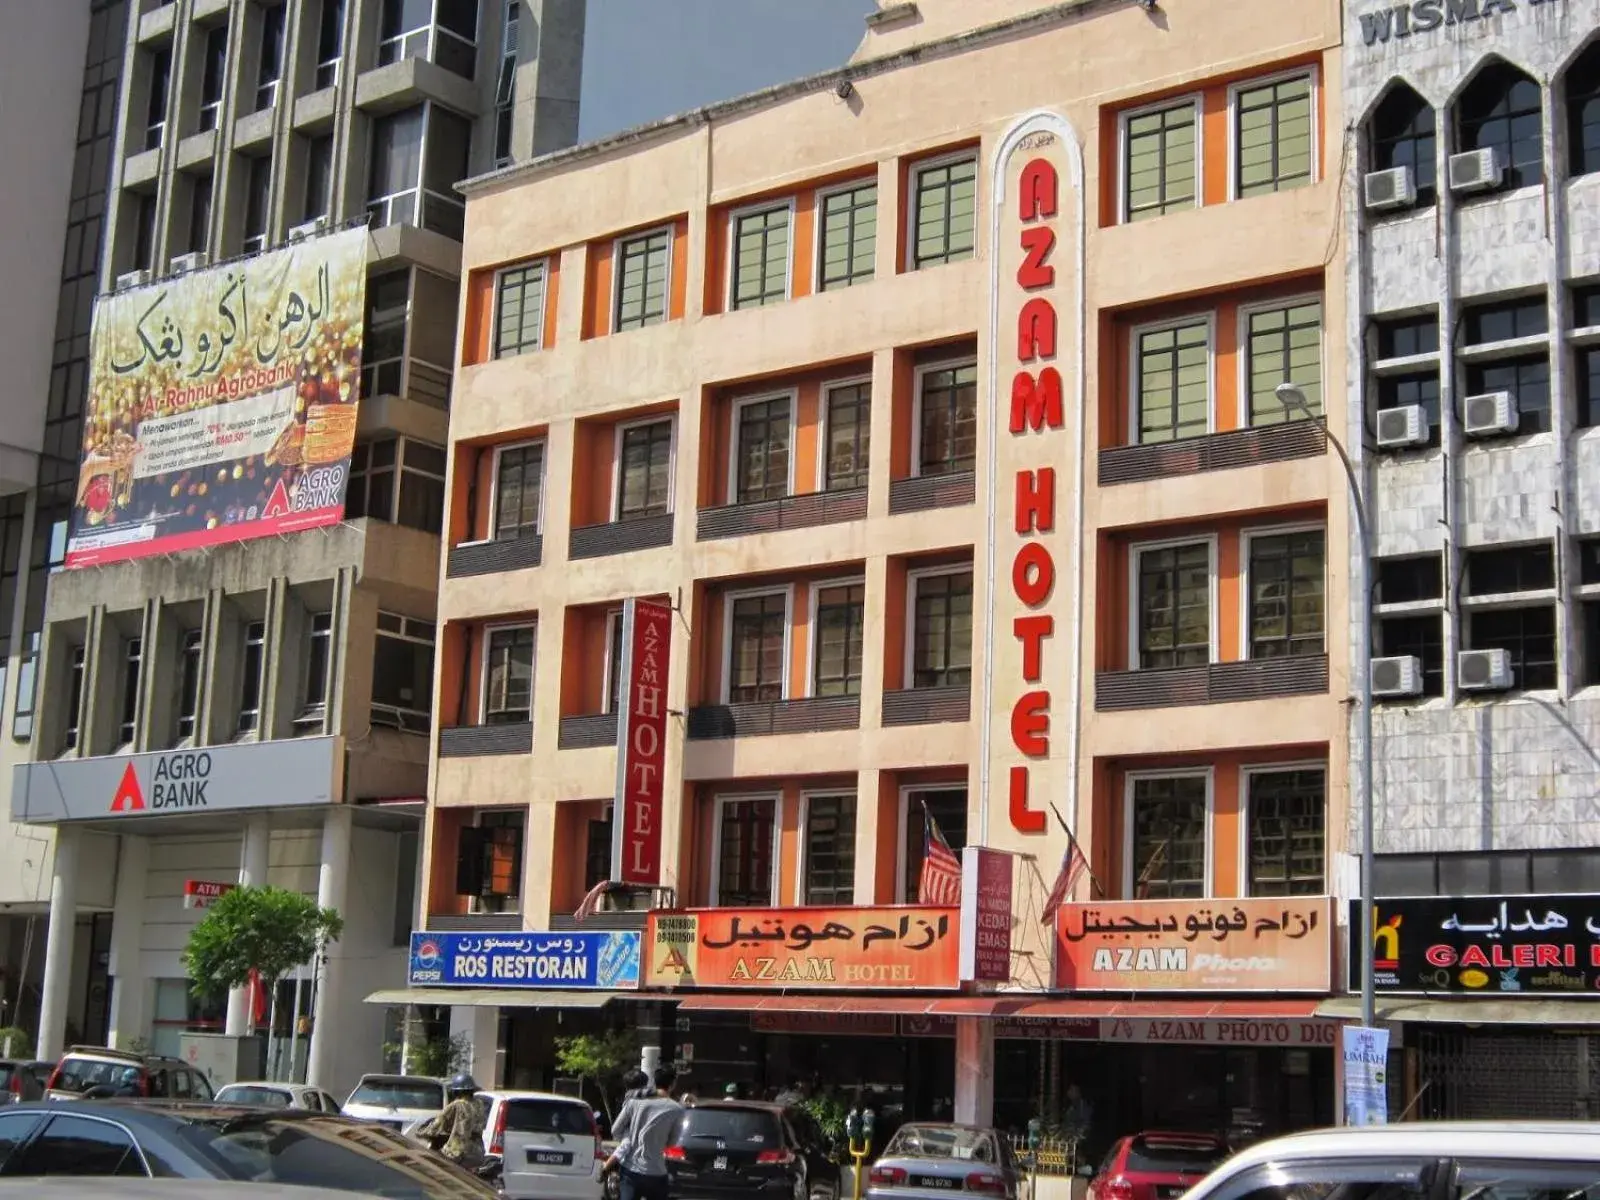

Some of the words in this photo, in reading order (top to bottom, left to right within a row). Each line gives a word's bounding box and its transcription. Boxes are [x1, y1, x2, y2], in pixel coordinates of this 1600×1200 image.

[1009, 157, 1064, 434] AZAM
[216, 362, 293, 398] Agrobank
[300, 465, 344, 489] AGRO
[294, 485, 339, 513] BANK
[640, 620, 661, 685] AZAM
[1009, 467, 1056, 834] HOTEL
[154, 753, 213, 782] AGRO
[631, 685, 661, 875] HOTEL
[152, 780, 210, 809] BANK
[702, 915, 855, 951] هوتيل
[978, 931, 1009, 950] EMAS
[454, 954, 488, 978] ROS
[492, 955, 588, 980] RESTORAN
[729, 957, 836, 982] AZAM
[844, 964, 916, 982] HOTEL
[1092, 946, 1188, 972] AZAM
[1425, 944, 1576, 967] GALERI
[412, 970, 441, 982] PEPSI
[1146, 1021, 1207, 1041] AZAM
[1216, 1022, 1290, 1042] PHOTO
